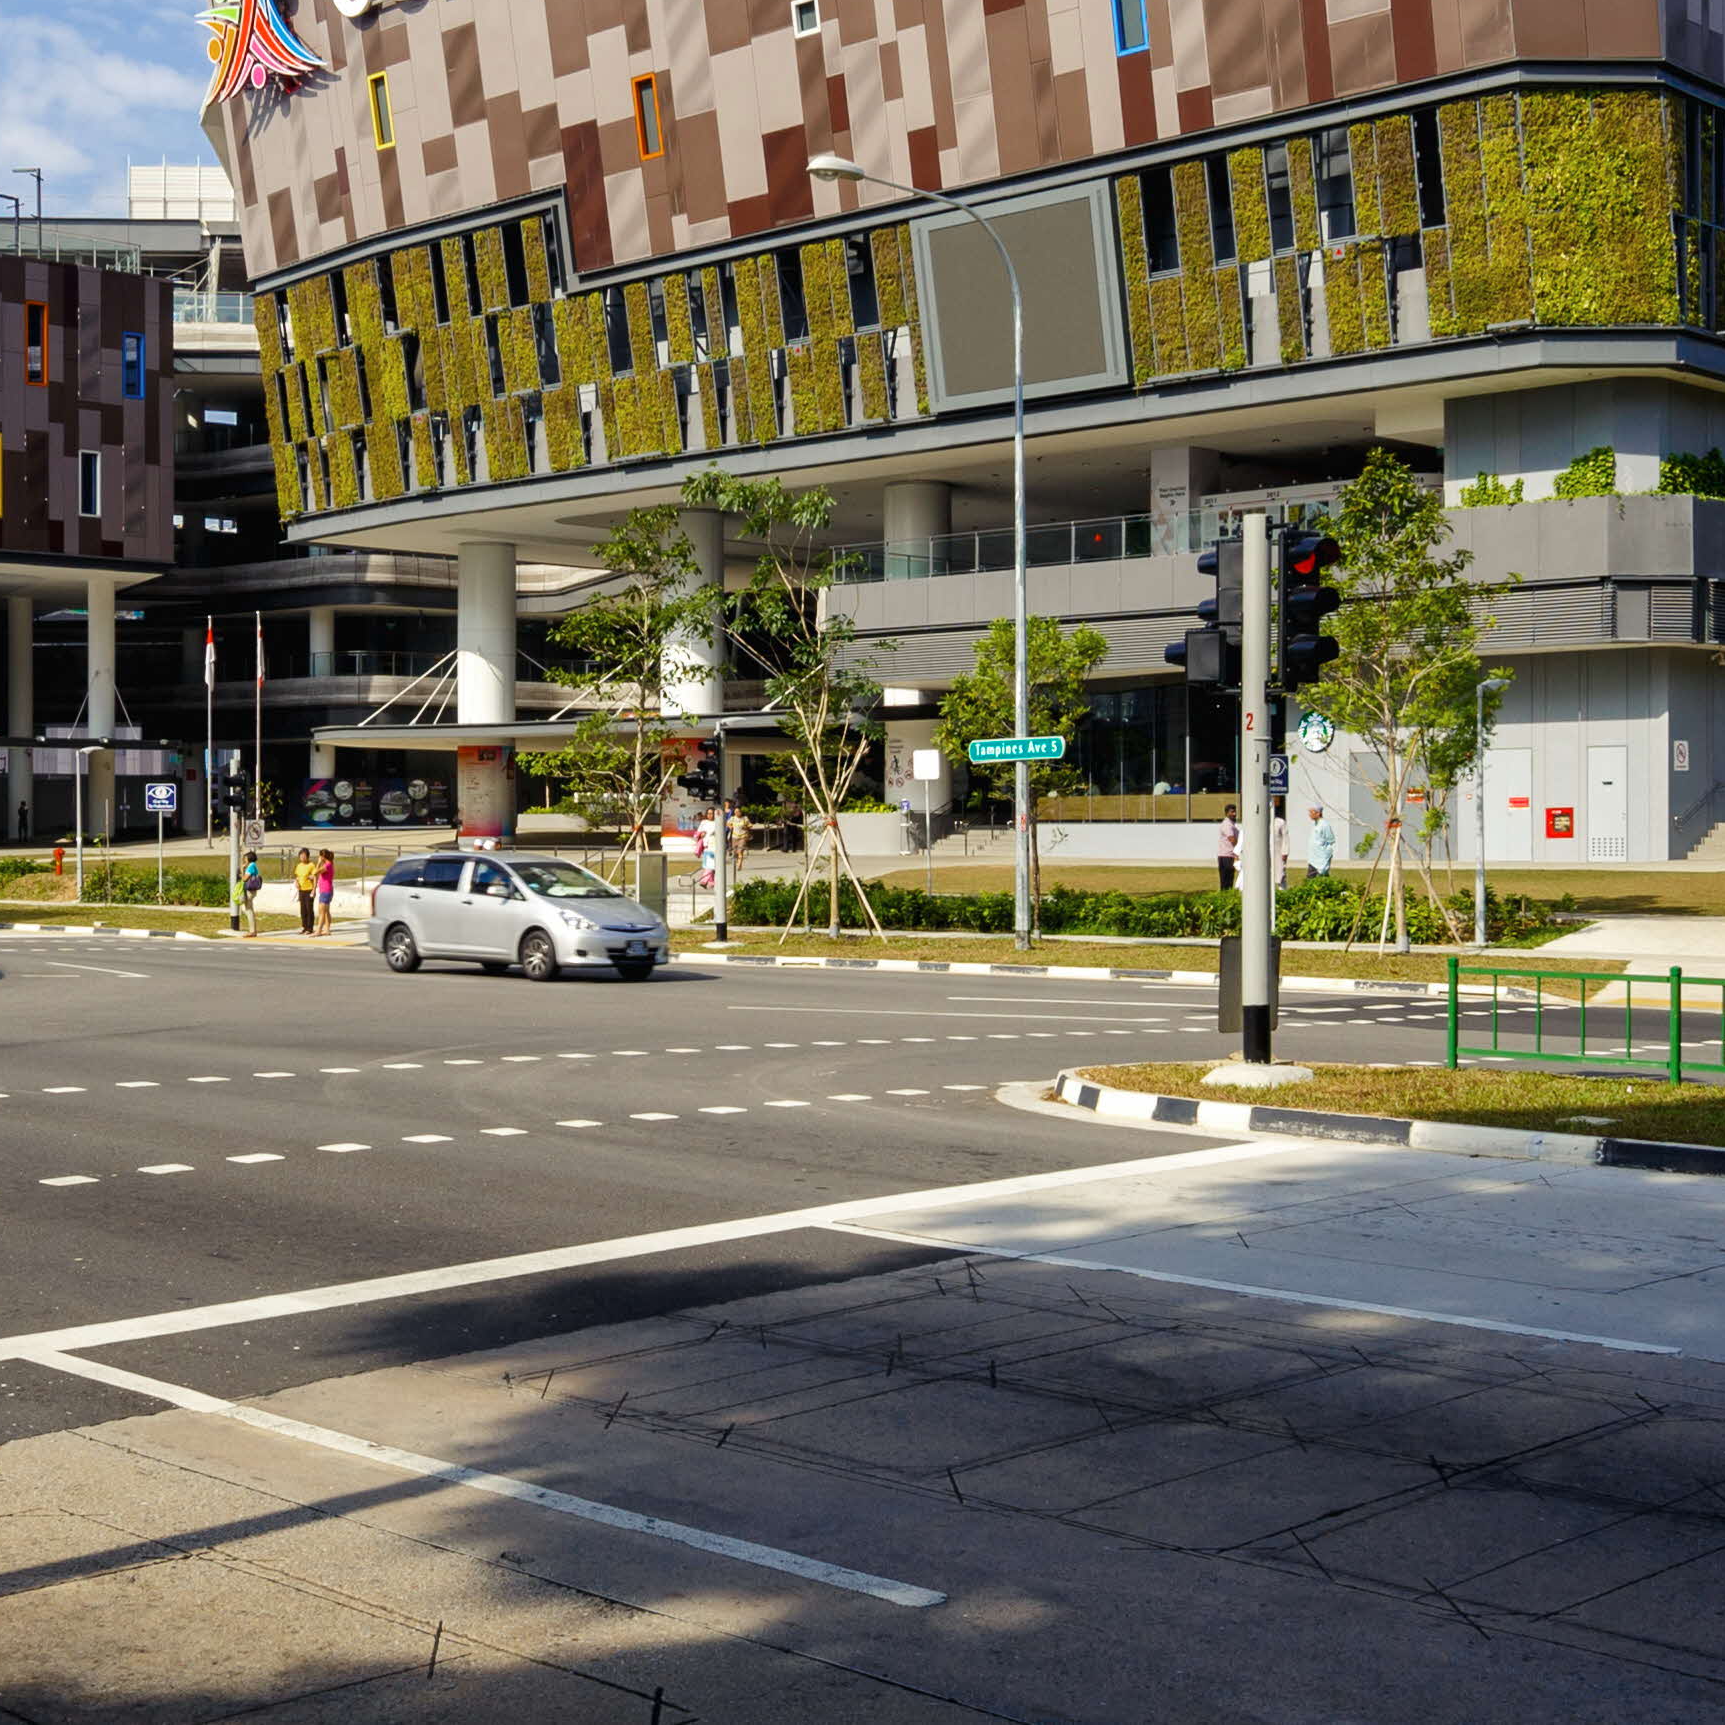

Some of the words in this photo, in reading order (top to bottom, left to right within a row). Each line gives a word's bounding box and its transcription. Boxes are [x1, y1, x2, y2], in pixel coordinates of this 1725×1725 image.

[1246, 713, 1254, 731] 2
[975, 743, 1023, 757] Tampines
[1027, 741, 1047, 753] Ave
[1051, 740, 1058, 752] 5
